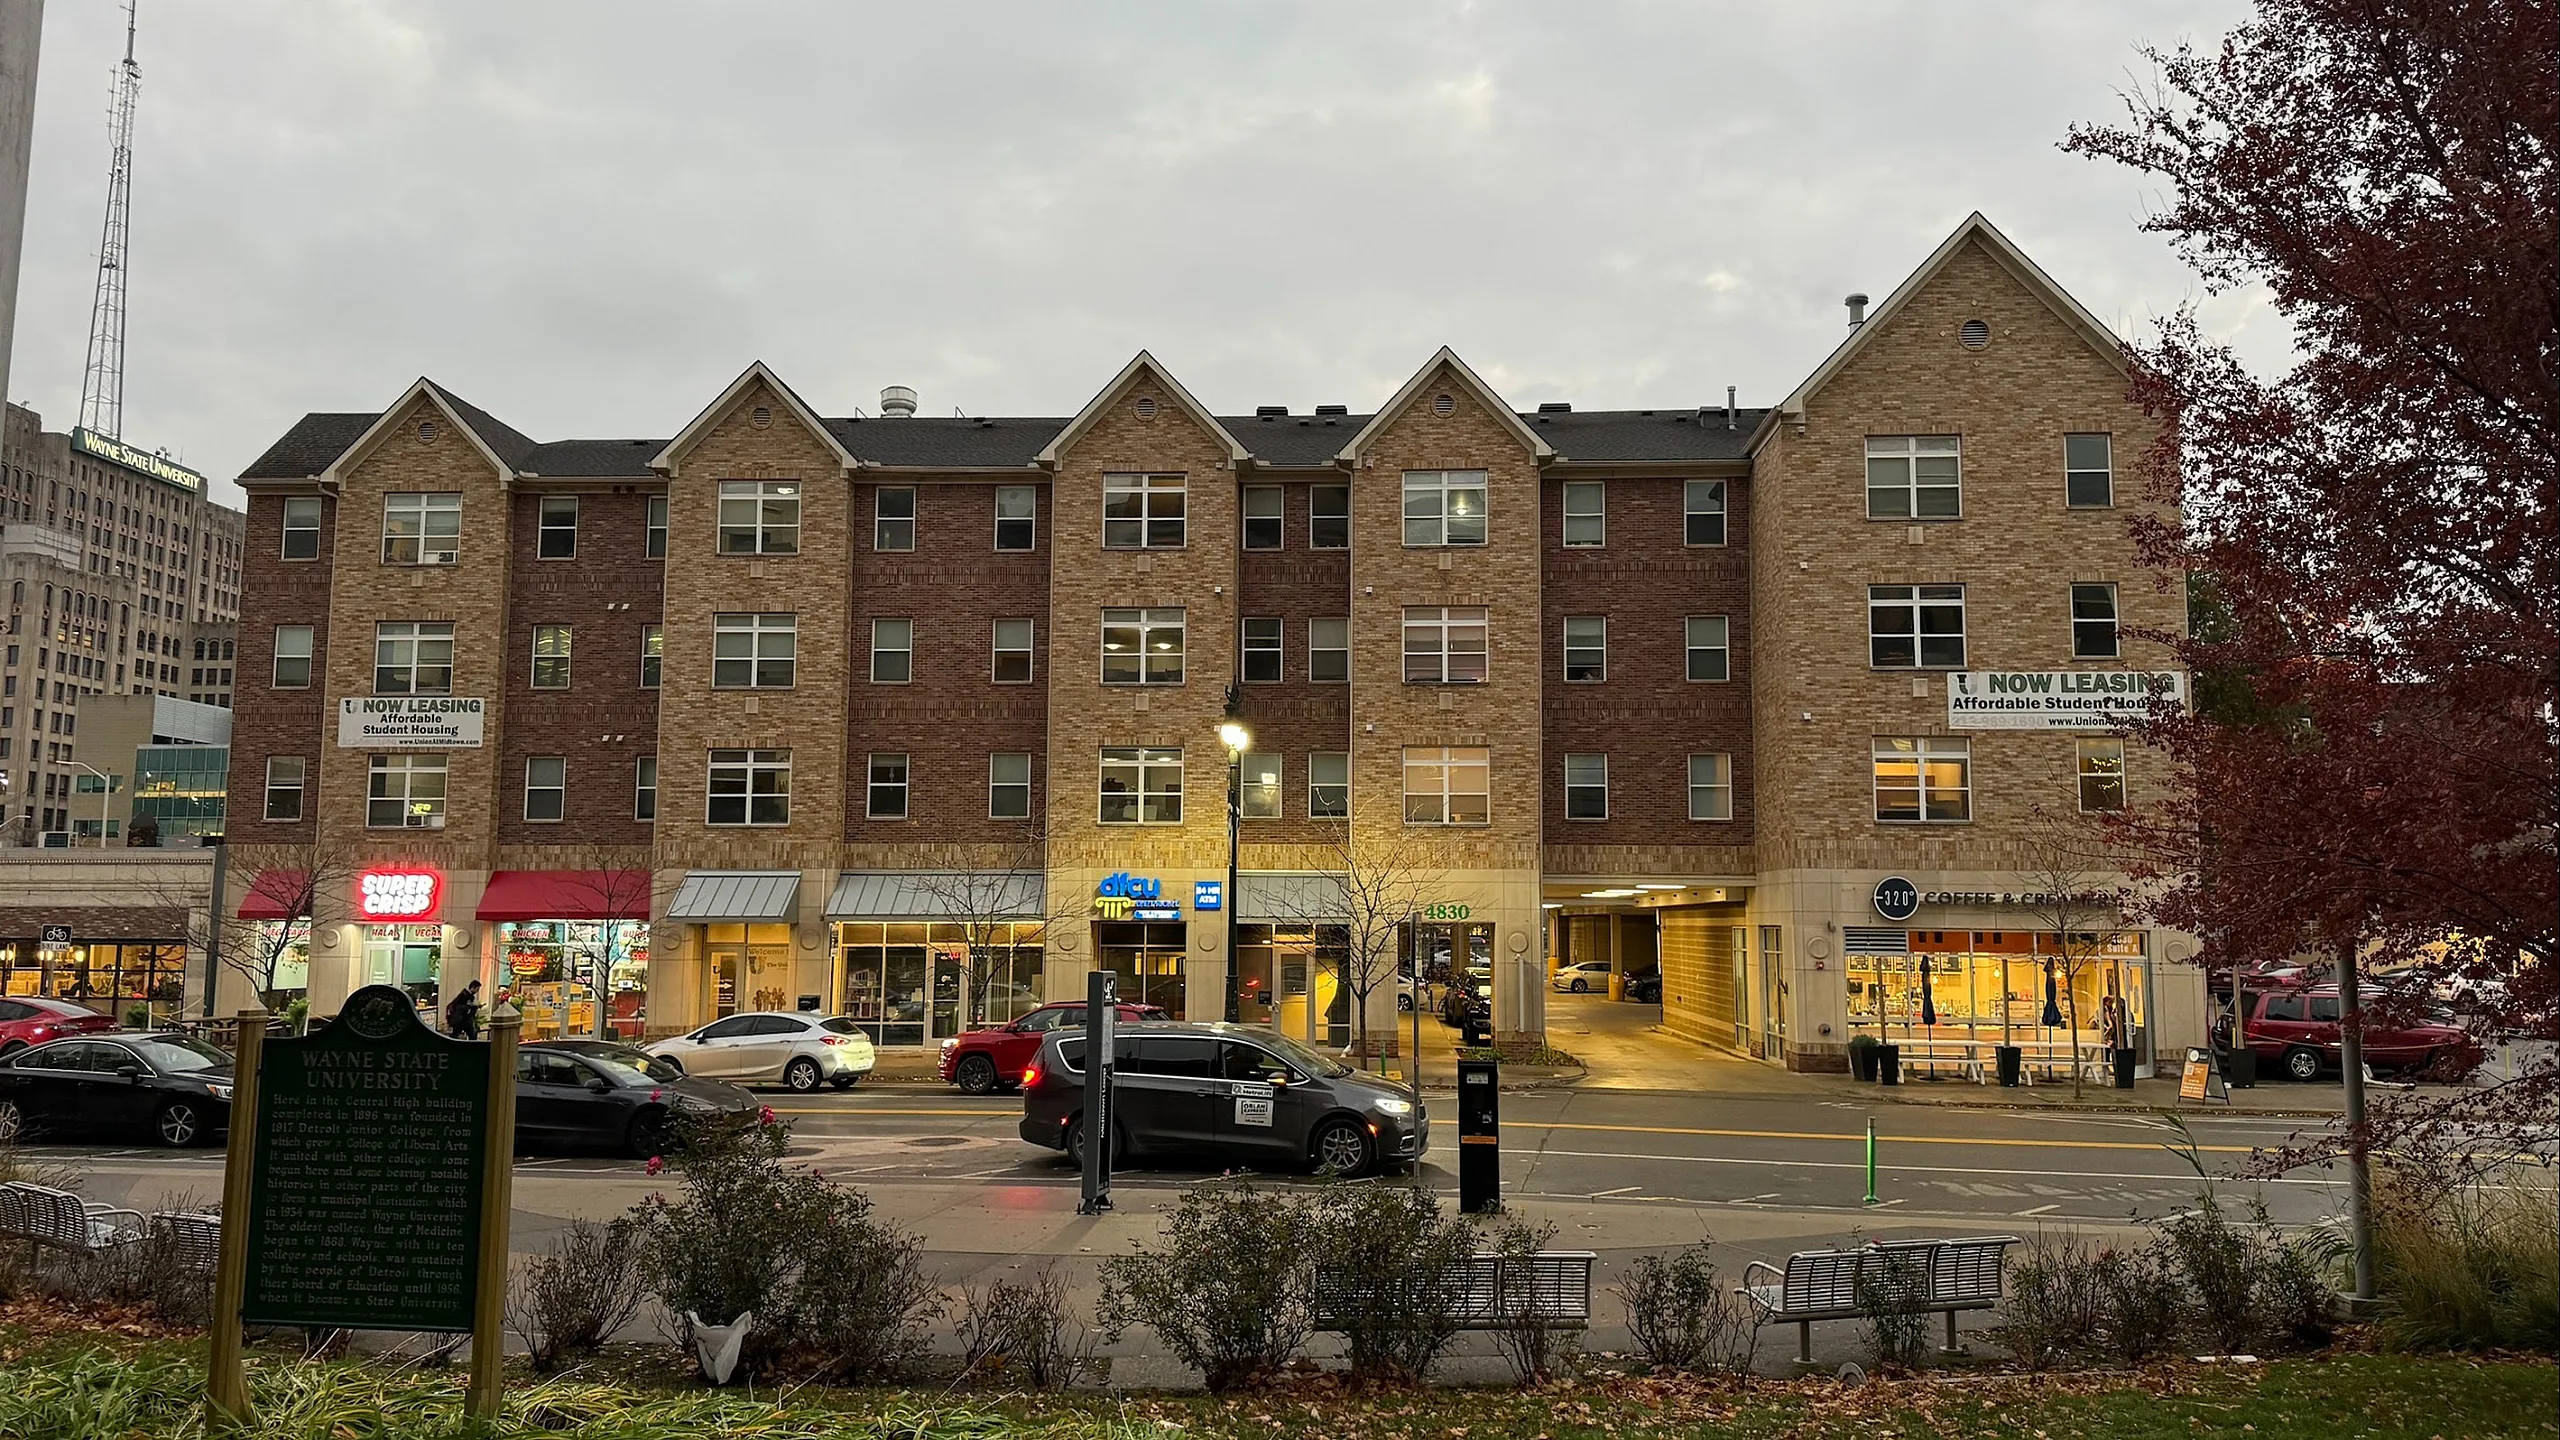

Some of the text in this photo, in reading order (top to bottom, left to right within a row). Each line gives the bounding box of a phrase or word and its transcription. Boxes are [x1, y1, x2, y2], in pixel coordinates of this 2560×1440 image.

[83, 431, 199, 489] WAYNE STATE UNIVERSITY
[1989, 674, 2052, 693] NOW
[363, 699, 481, 713] NOW LEASING
[1953, 697, 2040, 709] Affordable
[2045, 697, 2110, 709] Student
[380, 714, 442, 724] Affordable
[363, 725, 459, 736] Student Housing
[361, 874, 434, 896] SUPER
[1100, 872, 1160, 898] dfcu
[1198, 895, 1217, 904] ATM
[1923, 891, 1997, 905] COFFEE
[2002, 891, 2015, 904] &
[1425, 905, 1471, 919] 4830
[371, 929, 442, 937] HALAL VEGAN
[512, 929, 549, 939] CHICKEN
[2107, 944, 2138, 953] Suite A
[510, 953, 524, 962] Hot
[302, 1050, 449, 1070] WAYNE STATE
[306, 1071, 442, 1090] UNIVERSITY
